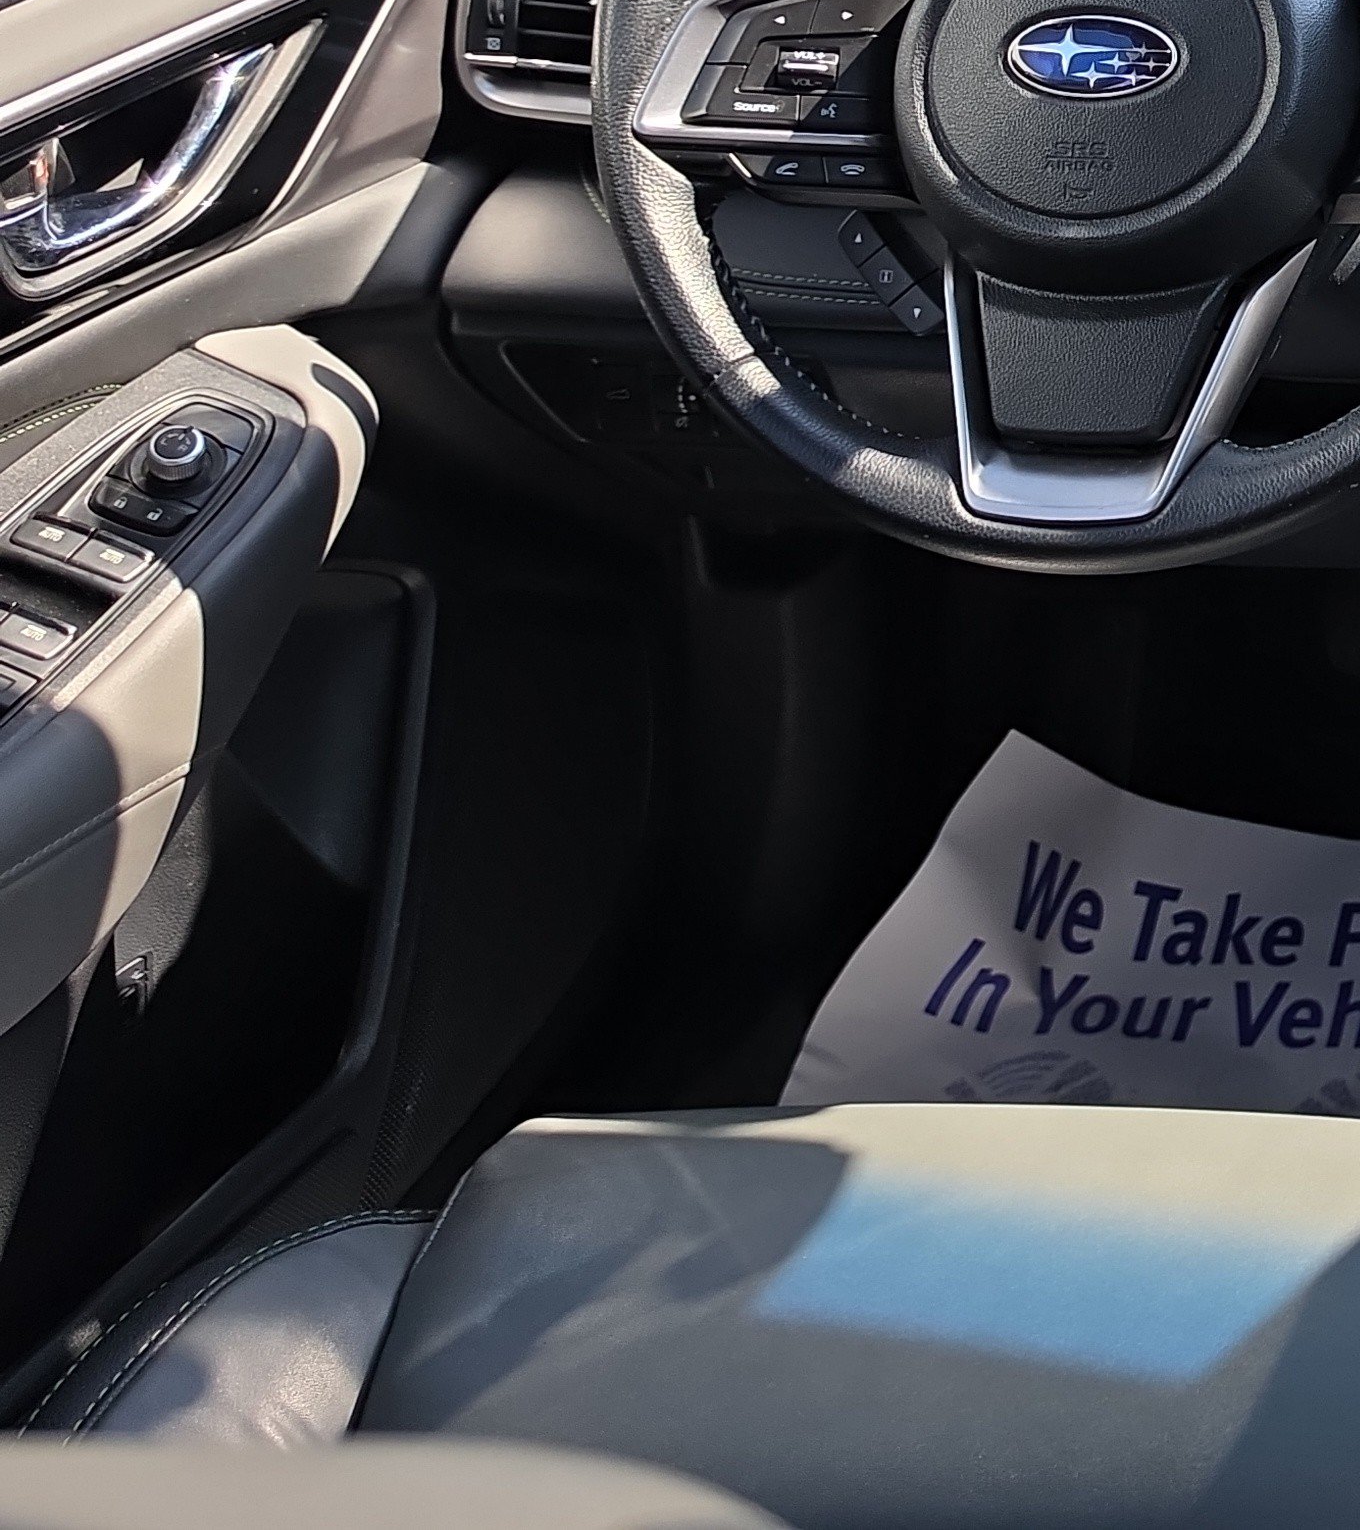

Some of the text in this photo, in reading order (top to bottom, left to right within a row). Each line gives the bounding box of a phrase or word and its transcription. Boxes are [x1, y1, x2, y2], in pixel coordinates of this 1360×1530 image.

[733, 101, 777, 113] Source
[1013, 839, 1105, 955] We
[1131, 879, 1306, 967] Take
[924, 937, 1012, 1035] In
[1033, 966, 1211, 1043] Your
